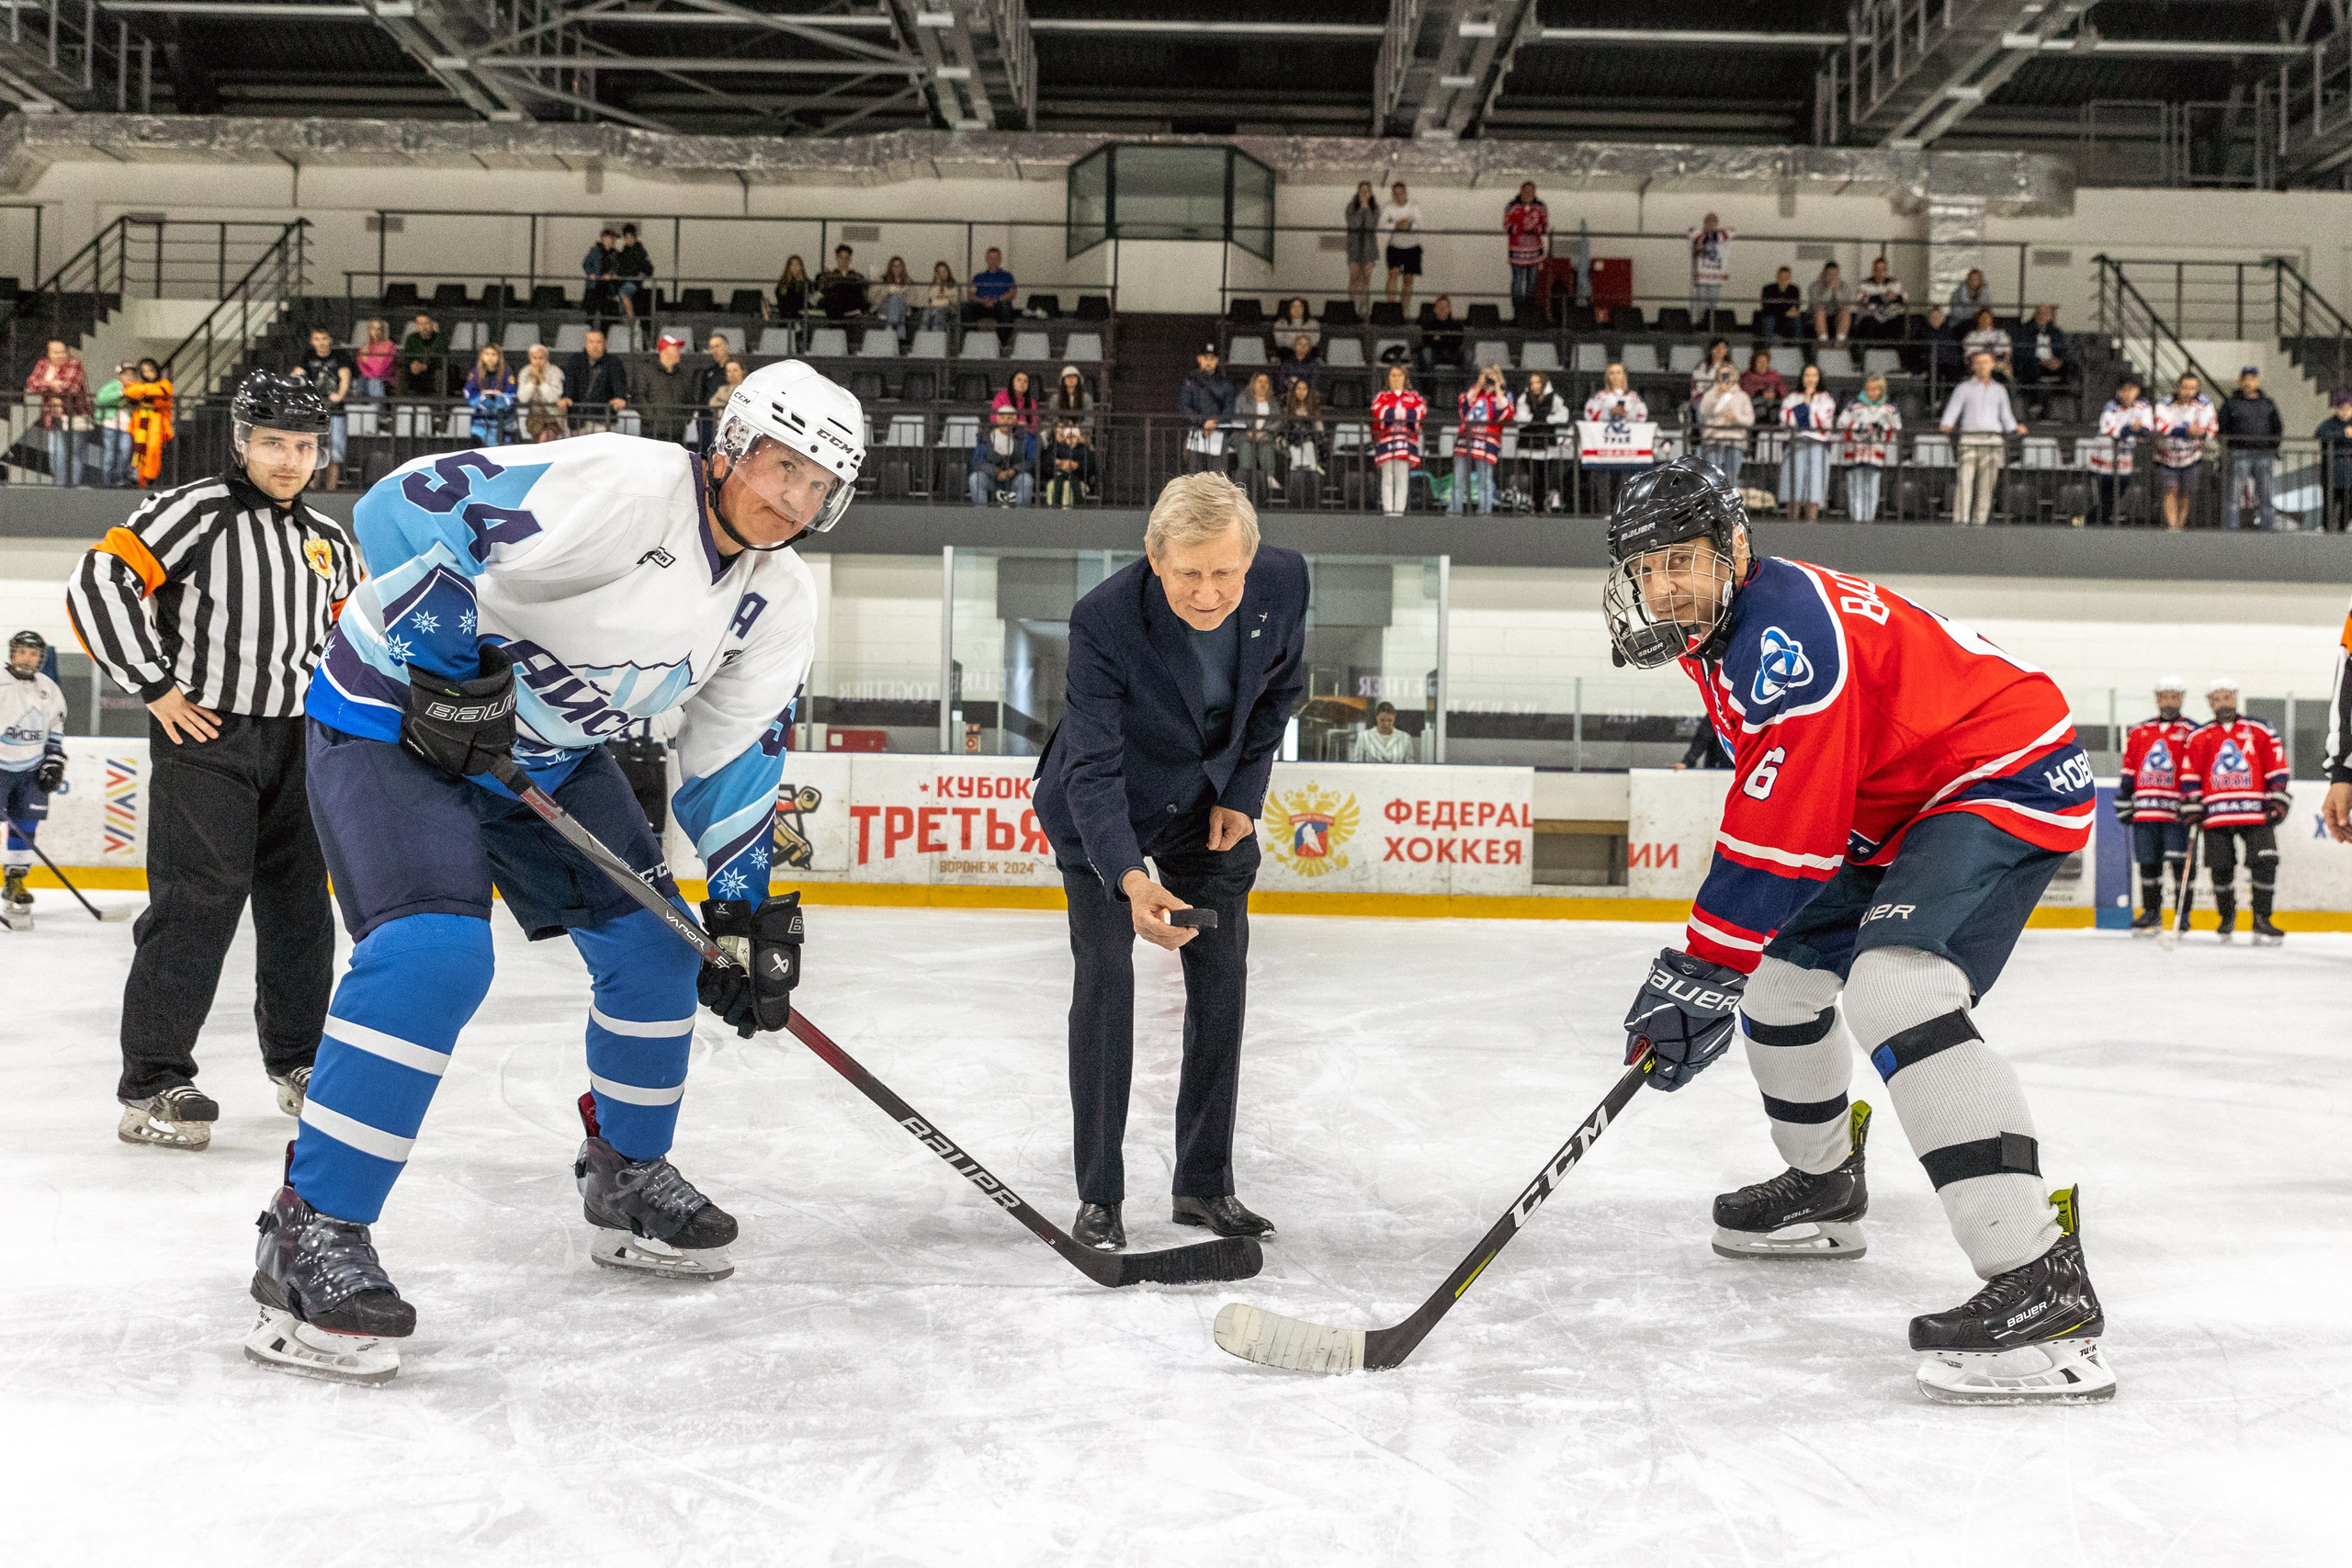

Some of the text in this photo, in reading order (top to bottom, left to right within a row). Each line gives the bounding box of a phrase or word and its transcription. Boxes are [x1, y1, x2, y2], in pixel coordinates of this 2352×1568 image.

[733, 391, 752, 405] CCM
[816, 427, 854, 455] CCM
[1621, 522, 1657, 542] BAUER
[730, 592, 769, 640] A
[1637, 642, 1665, 659] BAUER
[936, 775, 1033, 799] КУБОК
[1742, 745, 1787, 802] 6
[850, 805, 1050, 865] ТРЕТЬЯ
[1383, 837, 1522, 864] ХОККЕЯ
[939, 860, 1035, 874] ВОРОНЕЖ 2024
[666, 908, 706, 952] VAPOR
[899, 1116, 1022, 1211] BAUER
[1509, 1105, 1609, 1228] CCM
[2007, 1301, 2049, 1328] BAUER
